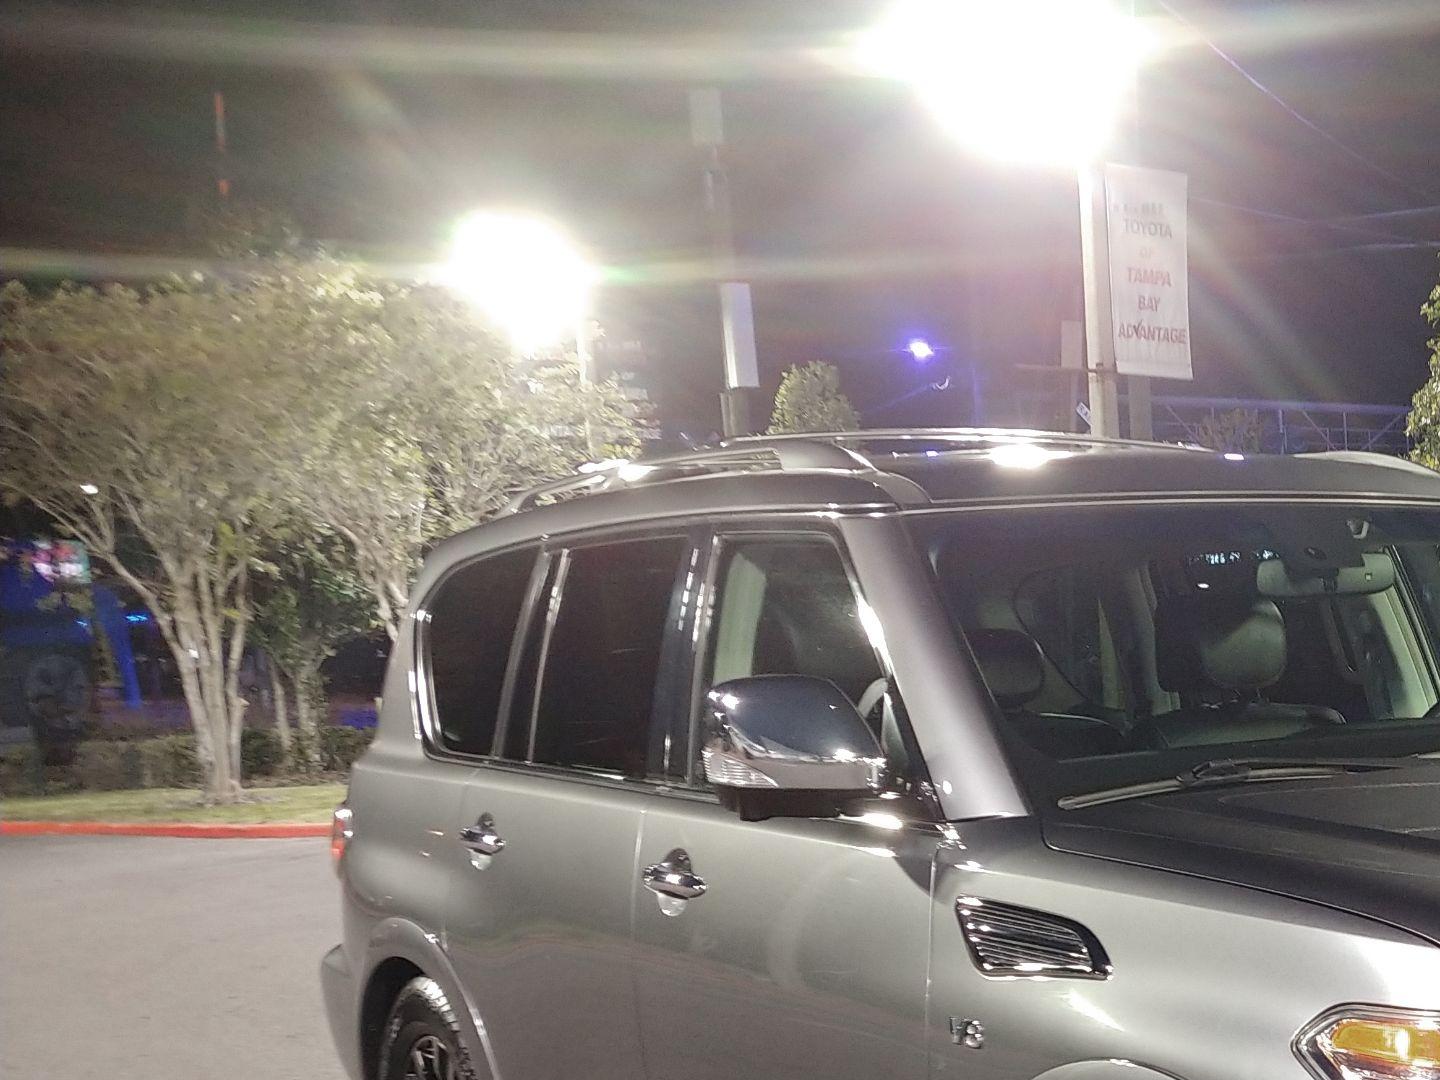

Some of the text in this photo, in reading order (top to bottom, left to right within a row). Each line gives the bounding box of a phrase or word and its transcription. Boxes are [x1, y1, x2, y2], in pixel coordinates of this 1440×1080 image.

[1124, 216, 1173, 240] TOYOTA
[1126, 266, 1172, 288] TAMPA
[1137, 294, 1161, 313] BAY
[1117, 318, 1188, 345] ADVANTAGE
